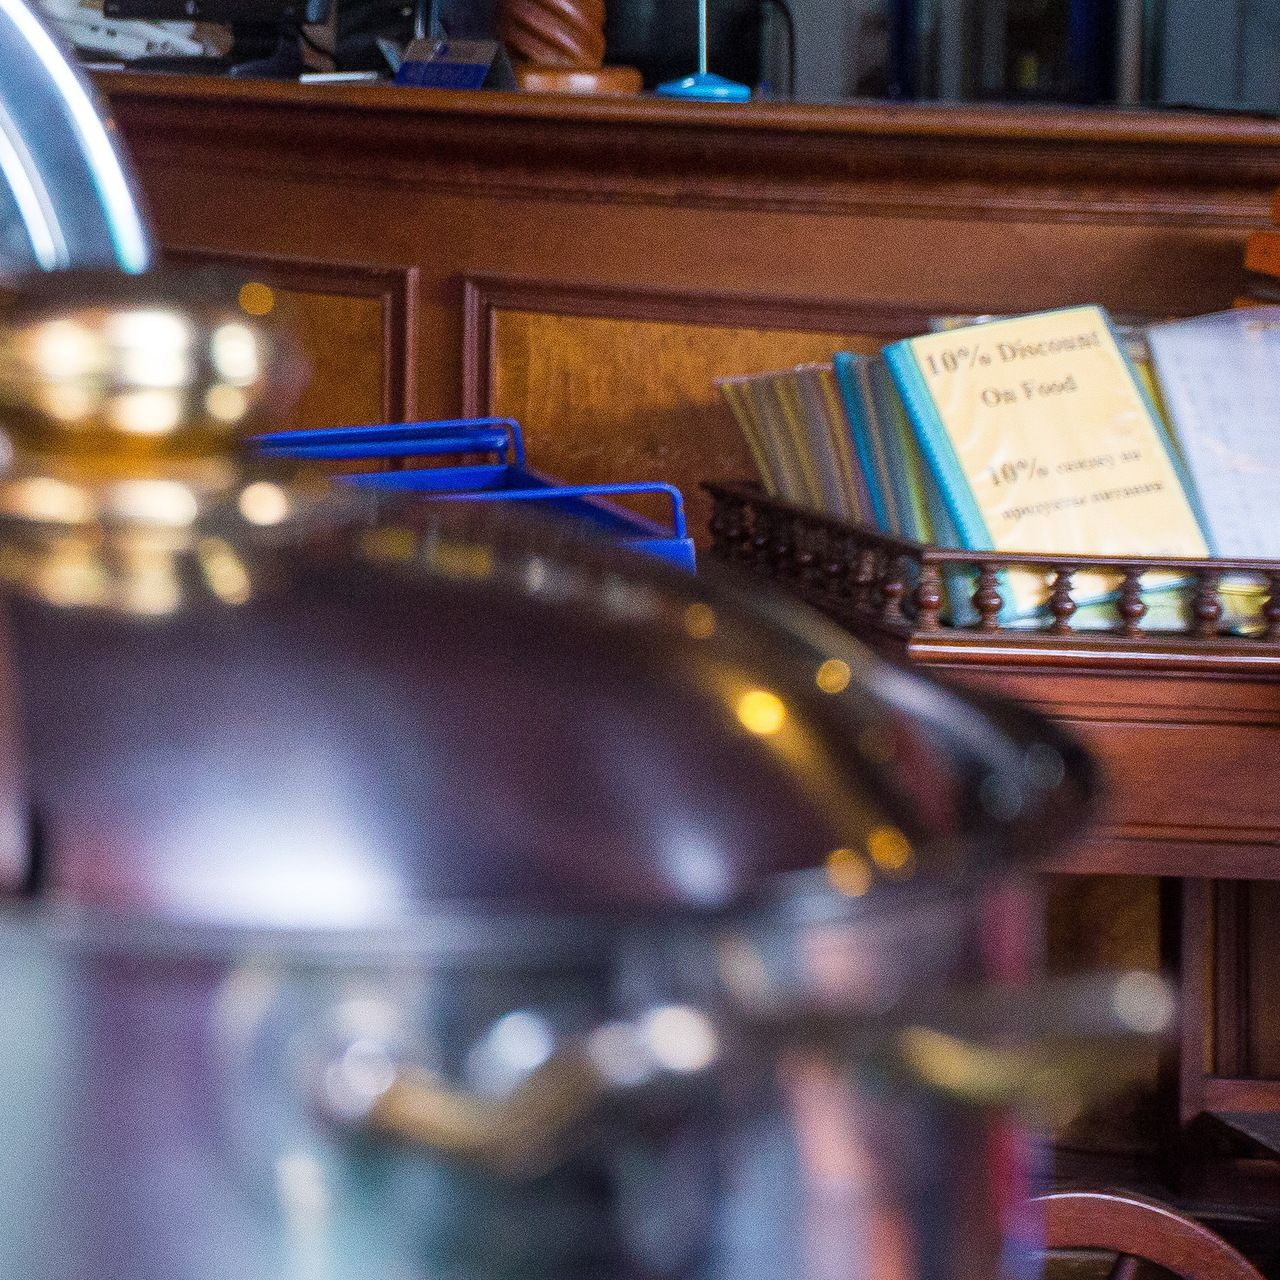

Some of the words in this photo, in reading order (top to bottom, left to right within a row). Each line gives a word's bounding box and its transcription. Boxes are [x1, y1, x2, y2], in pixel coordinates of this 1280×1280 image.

[925, 343, 992, 377] 10%
[997, 331, 1101, 363] Discount
[981, 386, 1017, 408] On
[1021, 374, 1078, 400] Food
[990, 456, 1049, 488] 10%
